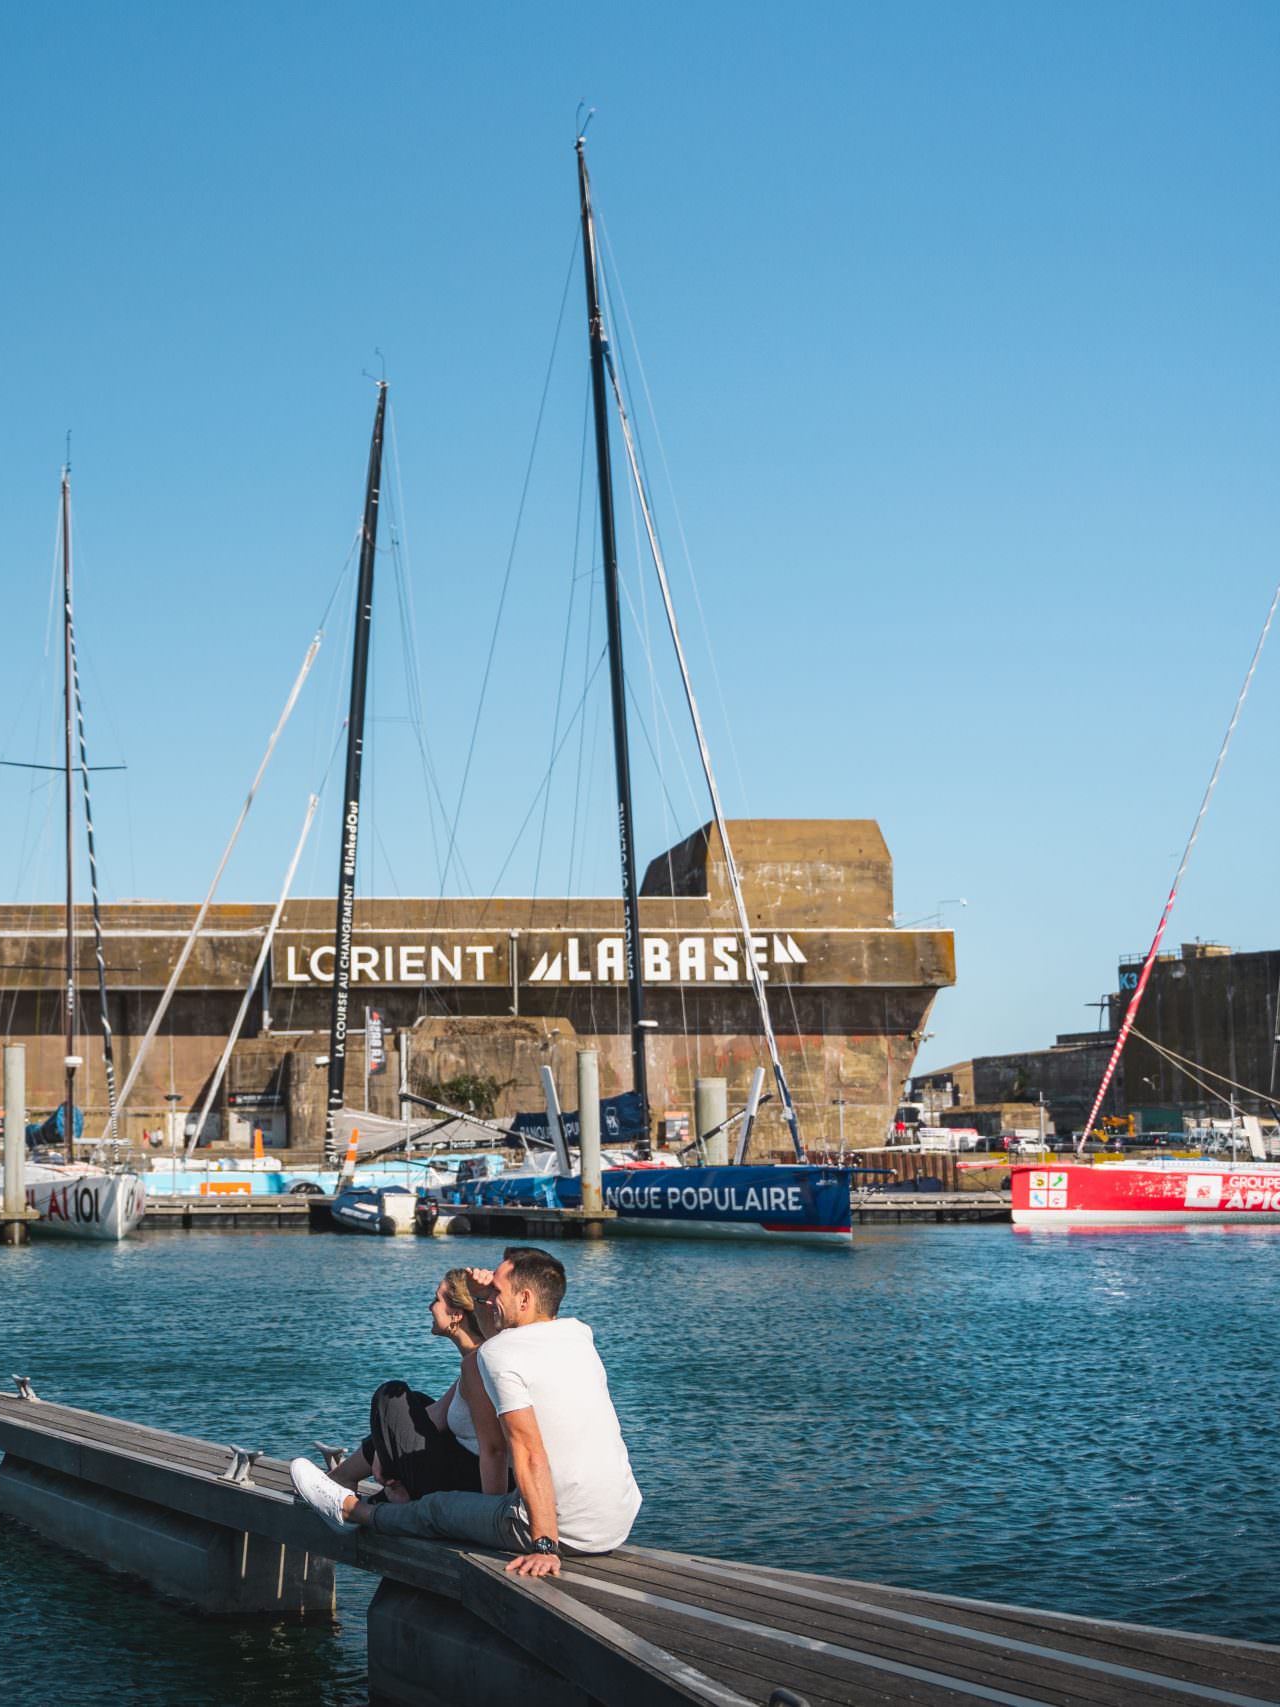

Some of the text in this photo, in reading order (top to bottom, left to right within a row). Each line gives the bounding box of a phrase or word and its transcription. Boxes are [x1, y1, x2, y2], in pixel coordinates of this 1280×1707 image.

[343, 801, 359, 876] #LinkedOut
[339, 884, 354, 970] CHANGEMENT
[287, 946, 493, 982] LORIENT
[567, 937, 769, 981] LA BASE
[338, 971, 349, 986] AU
[1120, 971, 1138, 990] K3
[335, 991, 349, 1040] COURSE
[74, 1187, 100, 1223] 101
[605, 1186, 803, 1211] NQUE POPULAIRE
